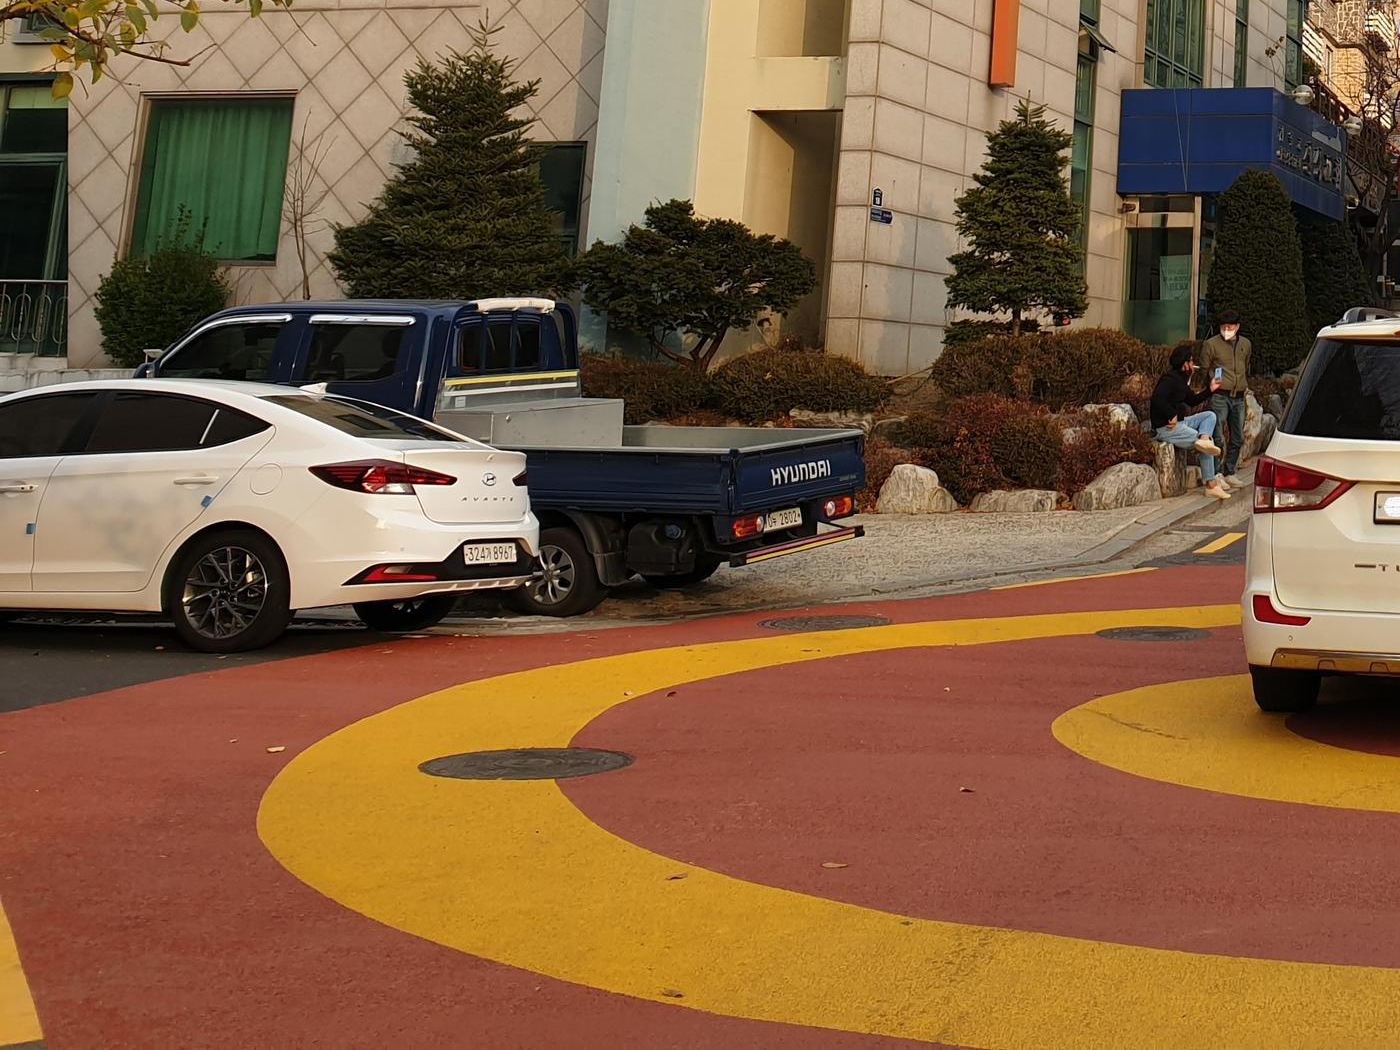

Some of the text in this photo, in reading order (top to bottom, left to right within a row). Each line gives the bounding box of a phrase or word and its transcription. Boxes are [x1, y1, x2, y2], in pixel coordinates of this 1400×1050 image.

[770, 459, 831, 486] HYUNDAI
[779, 510, 799, 526] 2802
[493, 545, 513, 560] 8967
